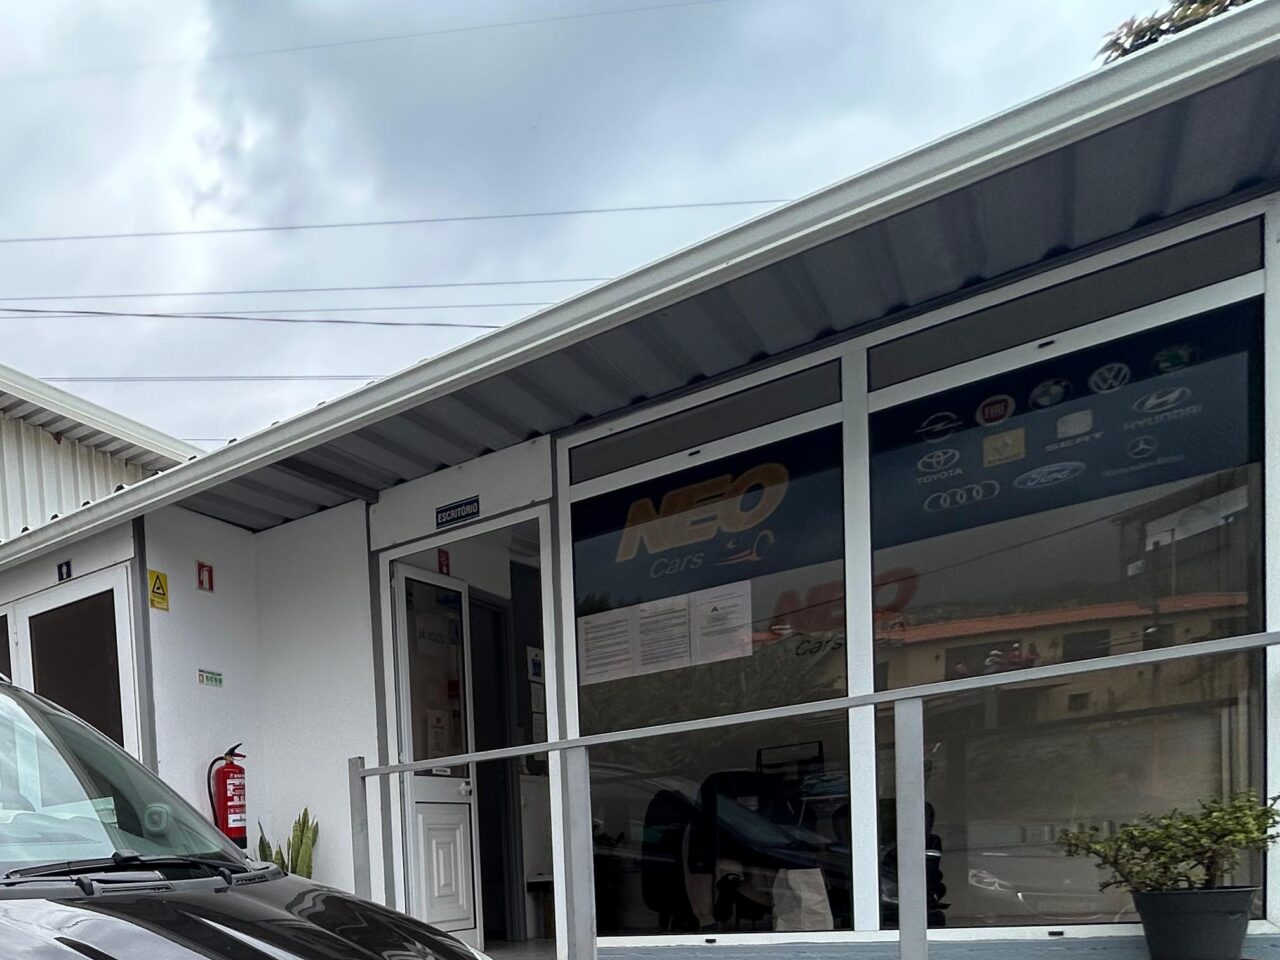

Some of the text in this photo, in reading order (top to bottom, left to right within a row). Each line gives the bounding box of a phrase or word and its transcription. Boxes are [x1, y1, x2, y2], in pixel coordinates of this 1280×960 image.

[1123, 403, 1203, 431] HYUNDAI
[1045, 431, 1105, 453] SEAT
[916, 467, 963, 484] TOYOTA
[437, 503, 478, 523] ESCRITÓRIO
[616, 462, 791, 563] NEO
[650, 551, 705, 579] Cars
[795, 636, 844, 657] Cars
